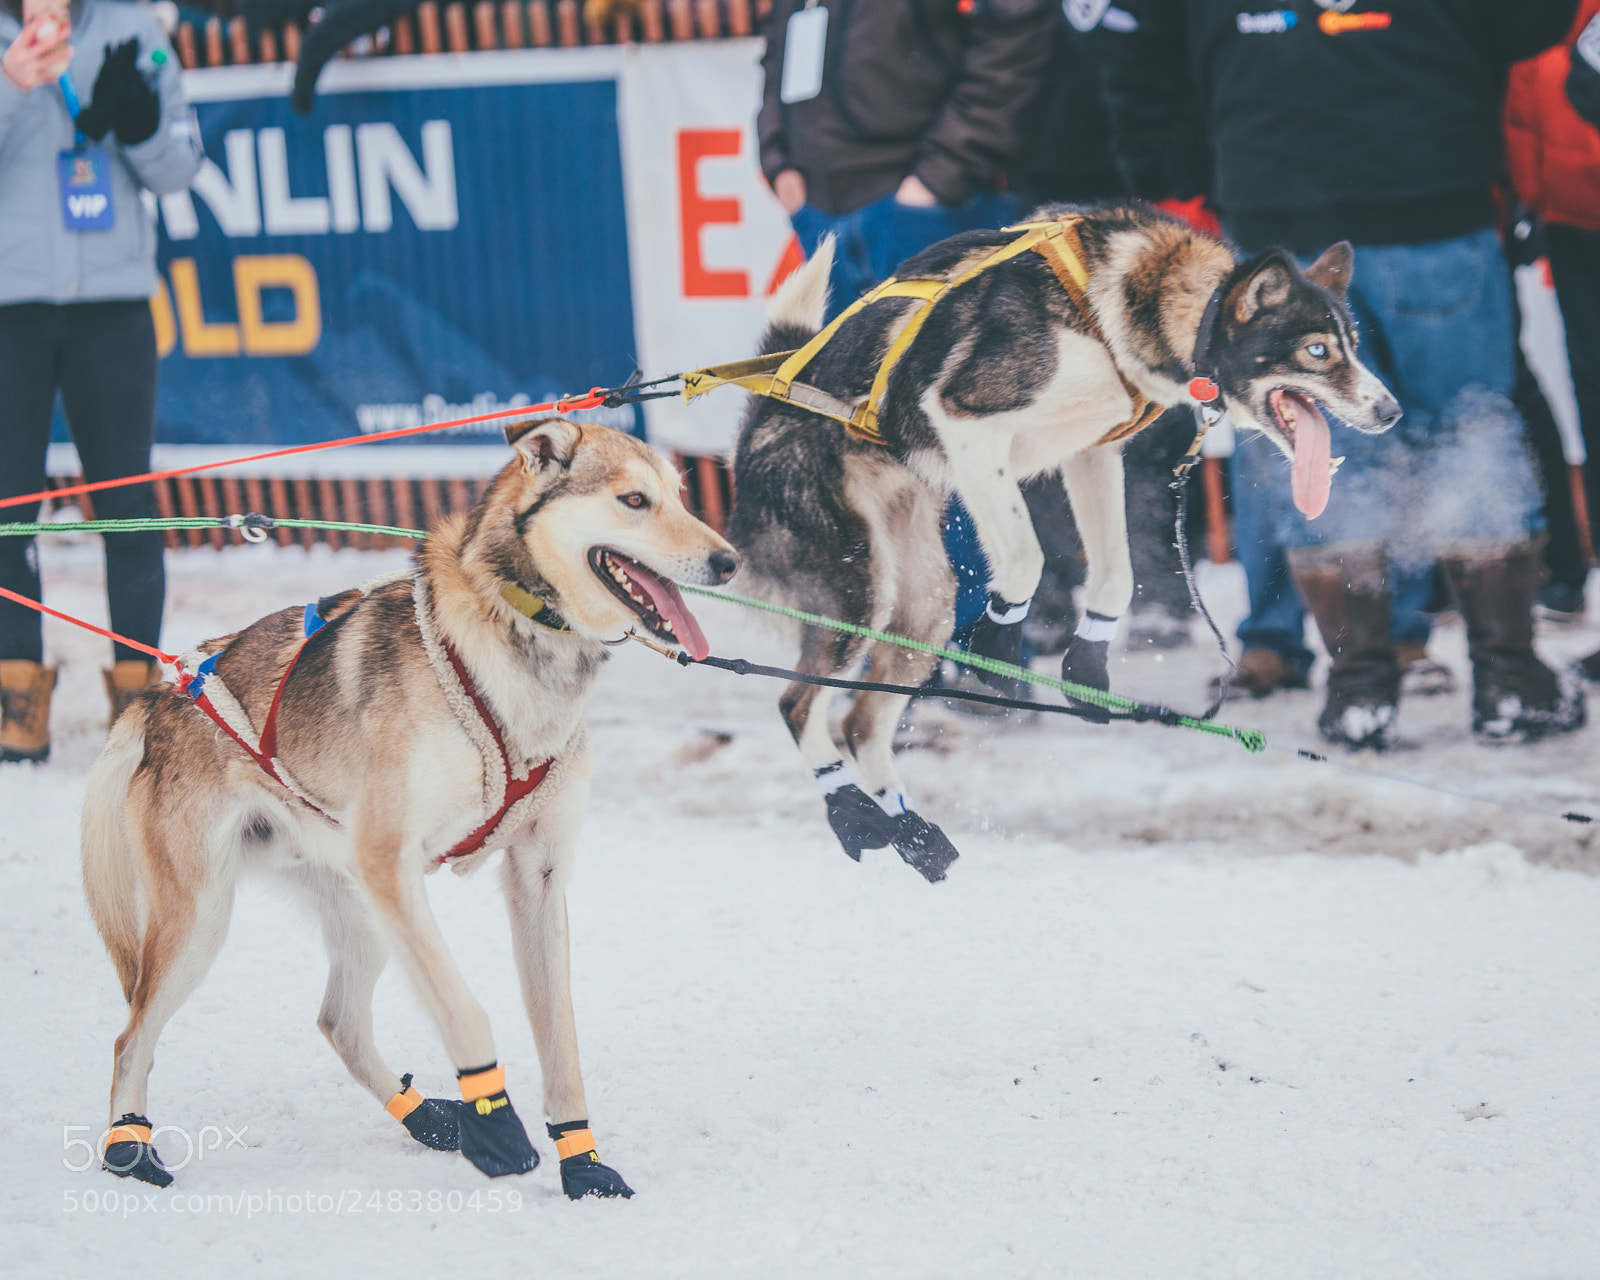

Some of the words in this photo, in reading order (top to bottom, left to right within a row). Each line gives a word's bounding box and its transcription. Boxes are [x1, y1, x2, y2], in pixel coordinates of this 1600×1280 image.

[67, 193, 108, 219] VIP
[141, 119, 459, 240] NLIN
[676, 127, 806, 298] E
